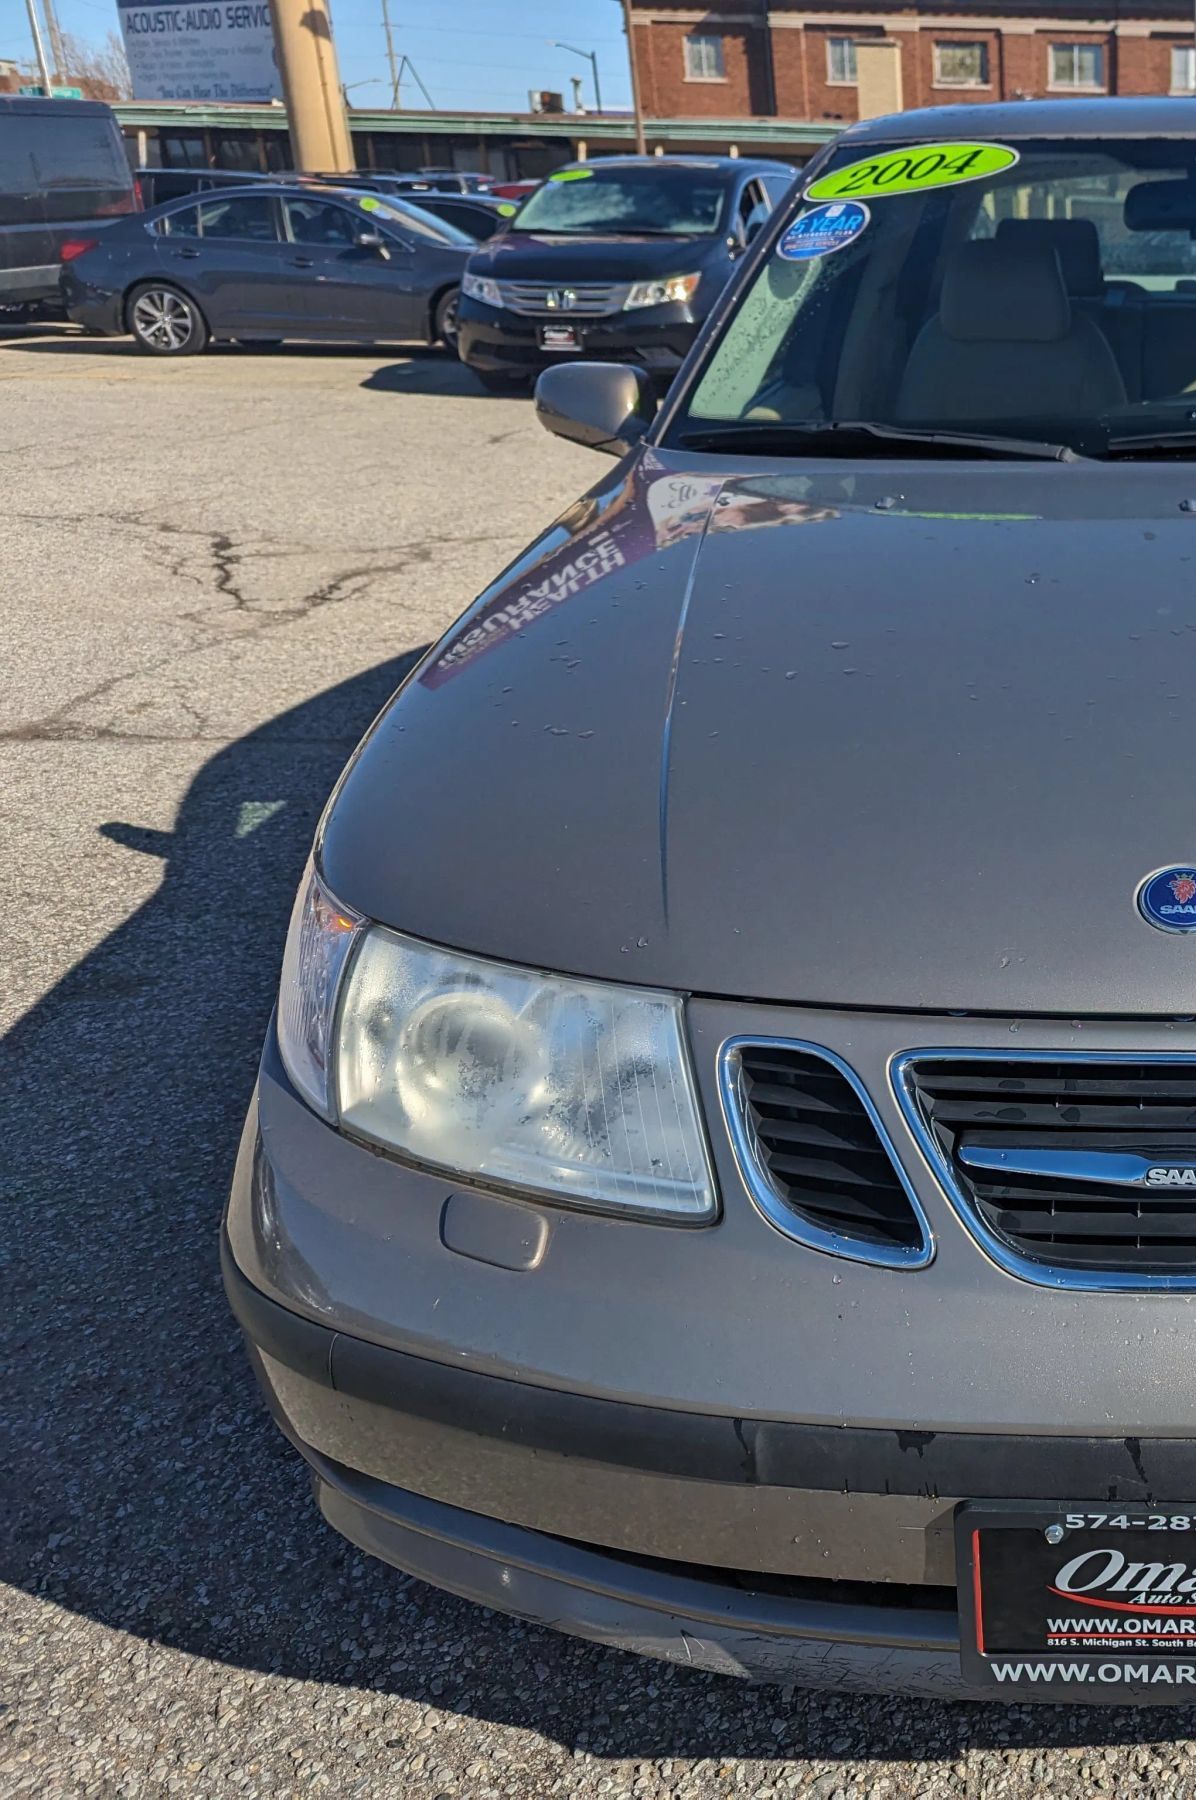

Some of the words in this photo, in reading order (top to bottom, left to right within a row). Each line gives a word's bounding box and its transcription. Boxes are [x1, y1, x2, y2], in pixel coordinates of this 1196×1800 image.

[226, 5, 271, 29] SERVIC
[835, 149, 984, 194] 2004
[810, 215, 863, 232] YEAR
[1128, 1592, 1183, 1604] Auto
[1047, 1638, 1067, 1646] 816
[1083, 1638, 1133, 1648] Michigan
[1135, 1639, 1149, 1647] St.
[1152, 1639, 1184, 1648] South
